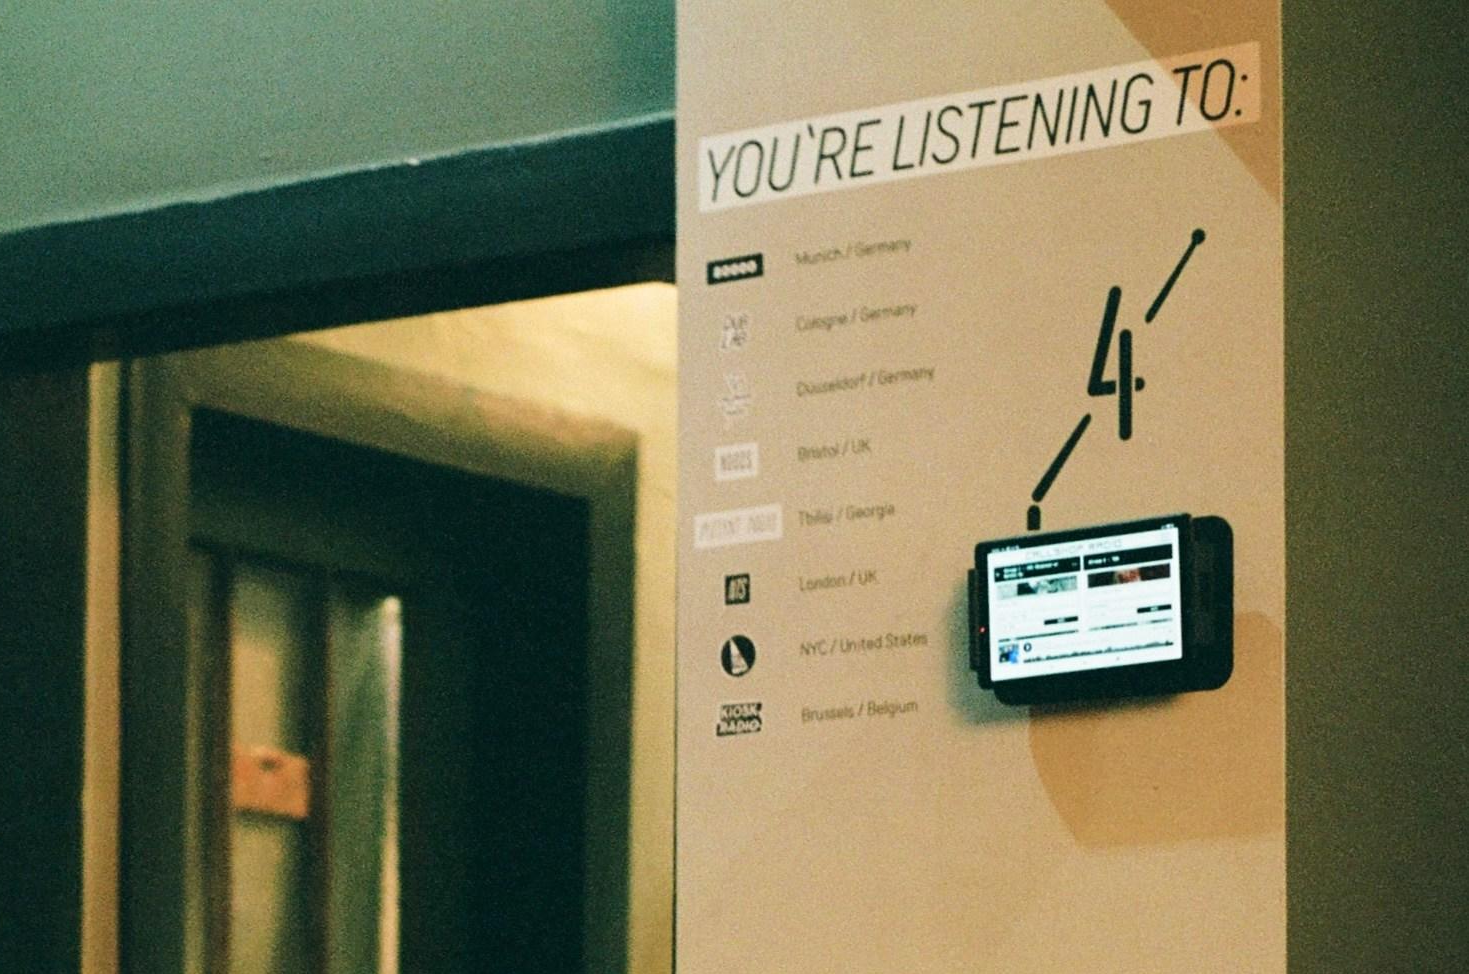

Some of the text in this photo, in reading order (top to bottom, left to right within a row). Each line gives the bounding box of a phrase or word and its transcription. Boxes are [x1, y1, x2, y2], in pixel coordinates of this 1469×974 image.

[708, 58, 1248, 203] YOU'RE LISTENING TO:
[855, 239, 911, 257] Germany
[796, 314, 848, 332] Cologne
[860, 304, 917, 322] Germany
[877, 367, 935, 385] Germany
[798, 443, 839, 462] Bristol
[851, 439, 872, 455] UK
[846, 503, 895, 521] Georgia
[799, 574, 845, 591] London
[858, 569, 878, 586] UK
[800, 641, 828, 656] NYC
[840, 635, 883, 653] United
[885, 632, 929, 648] States
[720, 702, 761, 719] KIOSK
[801, 706, 855, 723] Brussels
[867, 700, 918, 718] Belgium
[718, 718, 761, 734] RADIO
